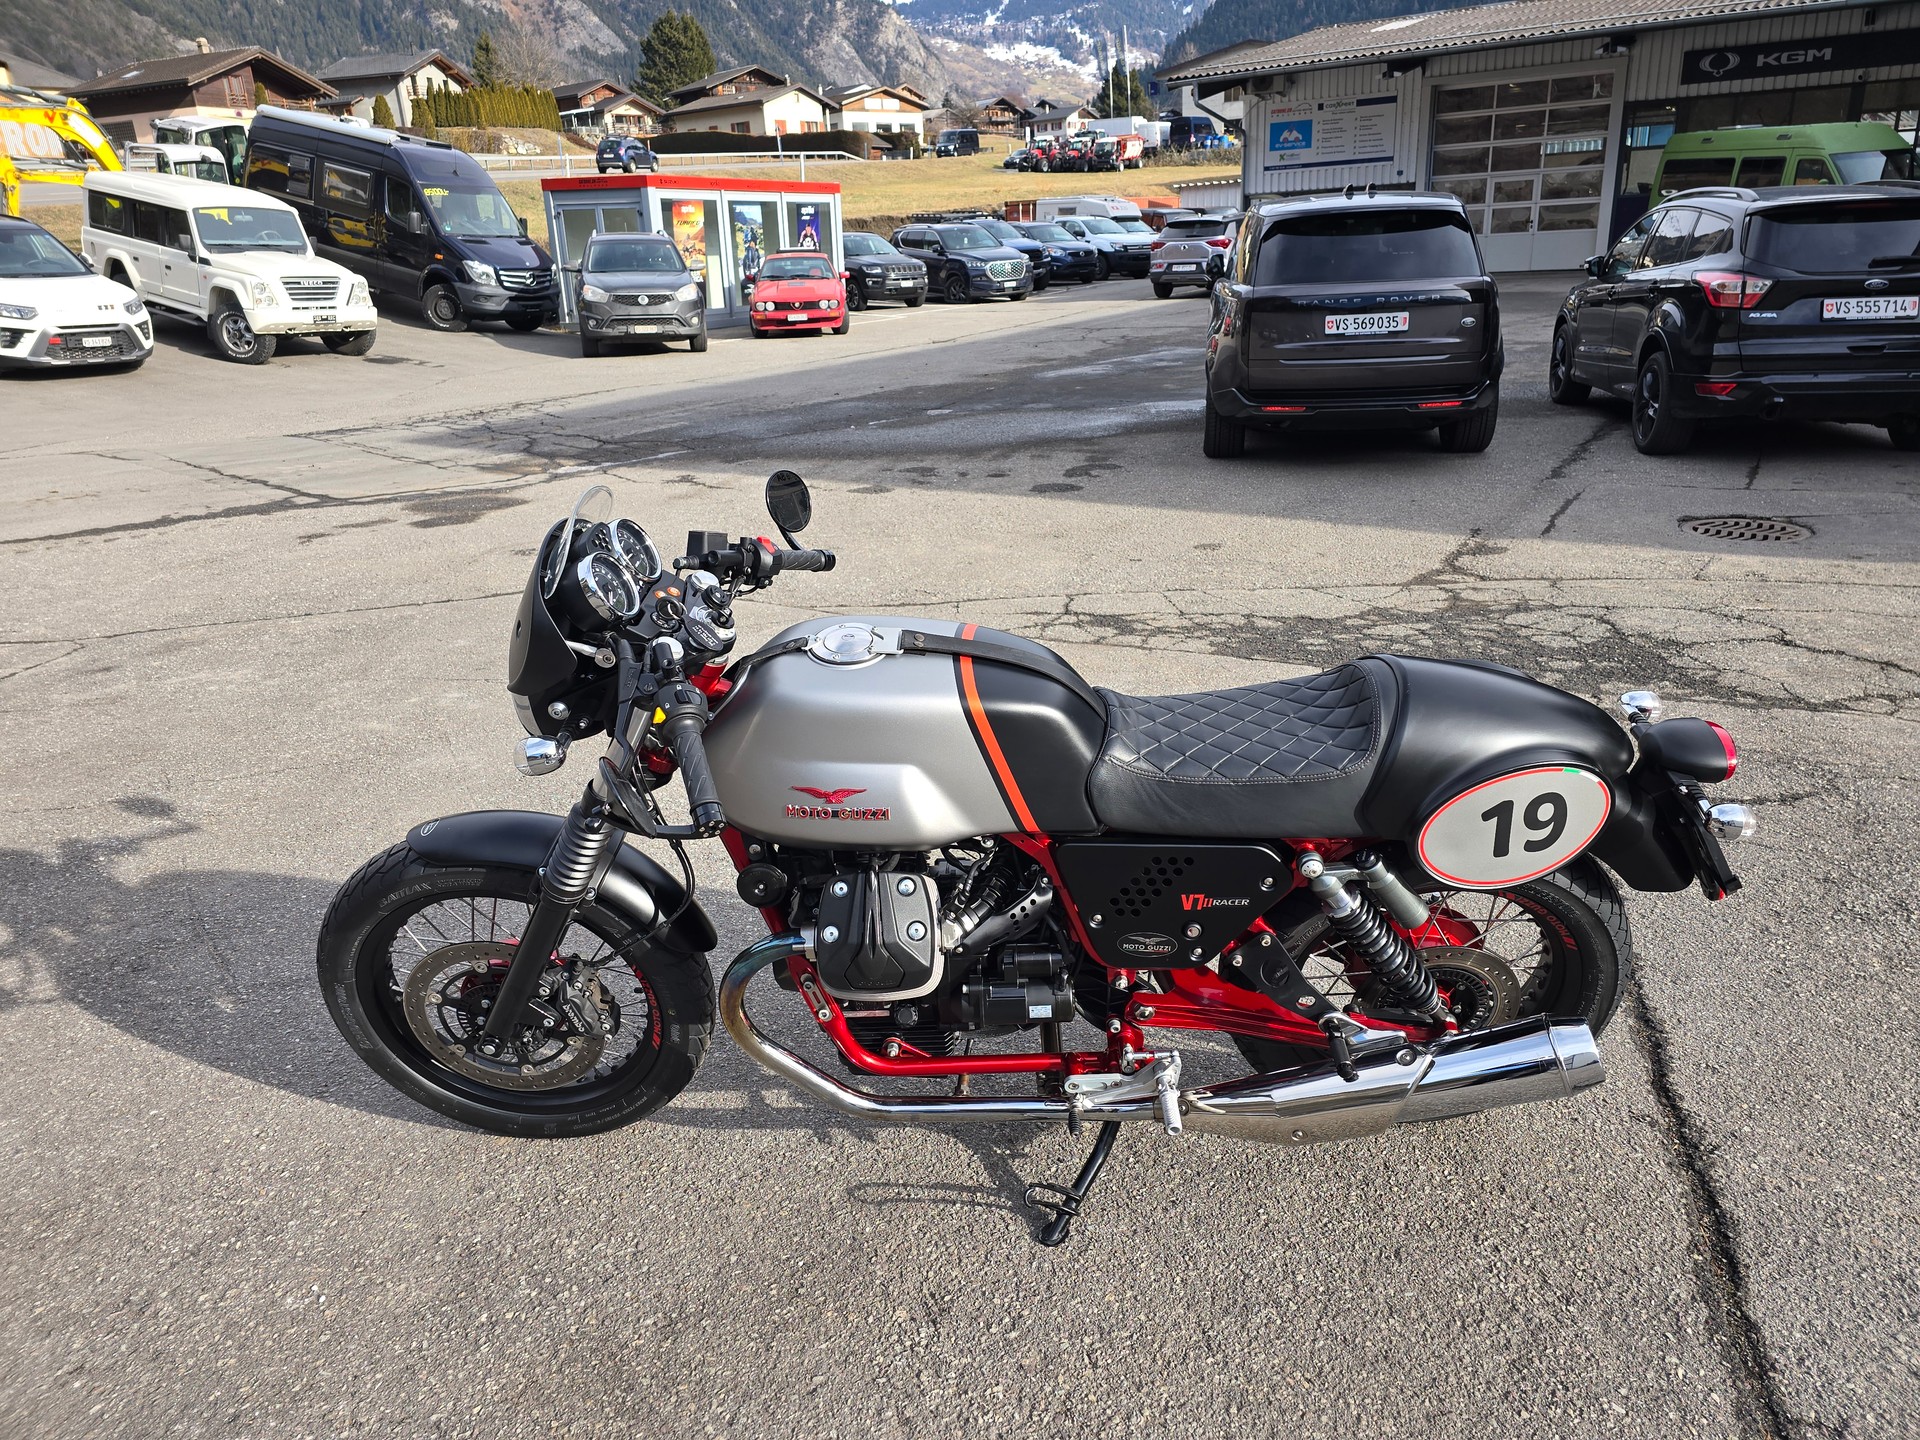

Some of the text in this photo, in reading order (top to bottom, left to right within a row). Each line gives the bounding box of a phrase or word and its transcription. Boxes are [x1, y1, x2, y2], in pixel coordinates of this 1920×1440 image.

[1756, 47, 1833, 67] KGM
[1298, 294, 1440, 307] RANGE ROVER
[786, 804, 891, 820] MOTO GUZZI
[1481, 792, 1567, 858] 19
[1181, 894, 1205, 910] V7
[1516, 896, 1571, 936] MOTO GUZZI
[562, 1003, 585, 1033] brembo
[652, 1009, 662, 1035] MOTO
